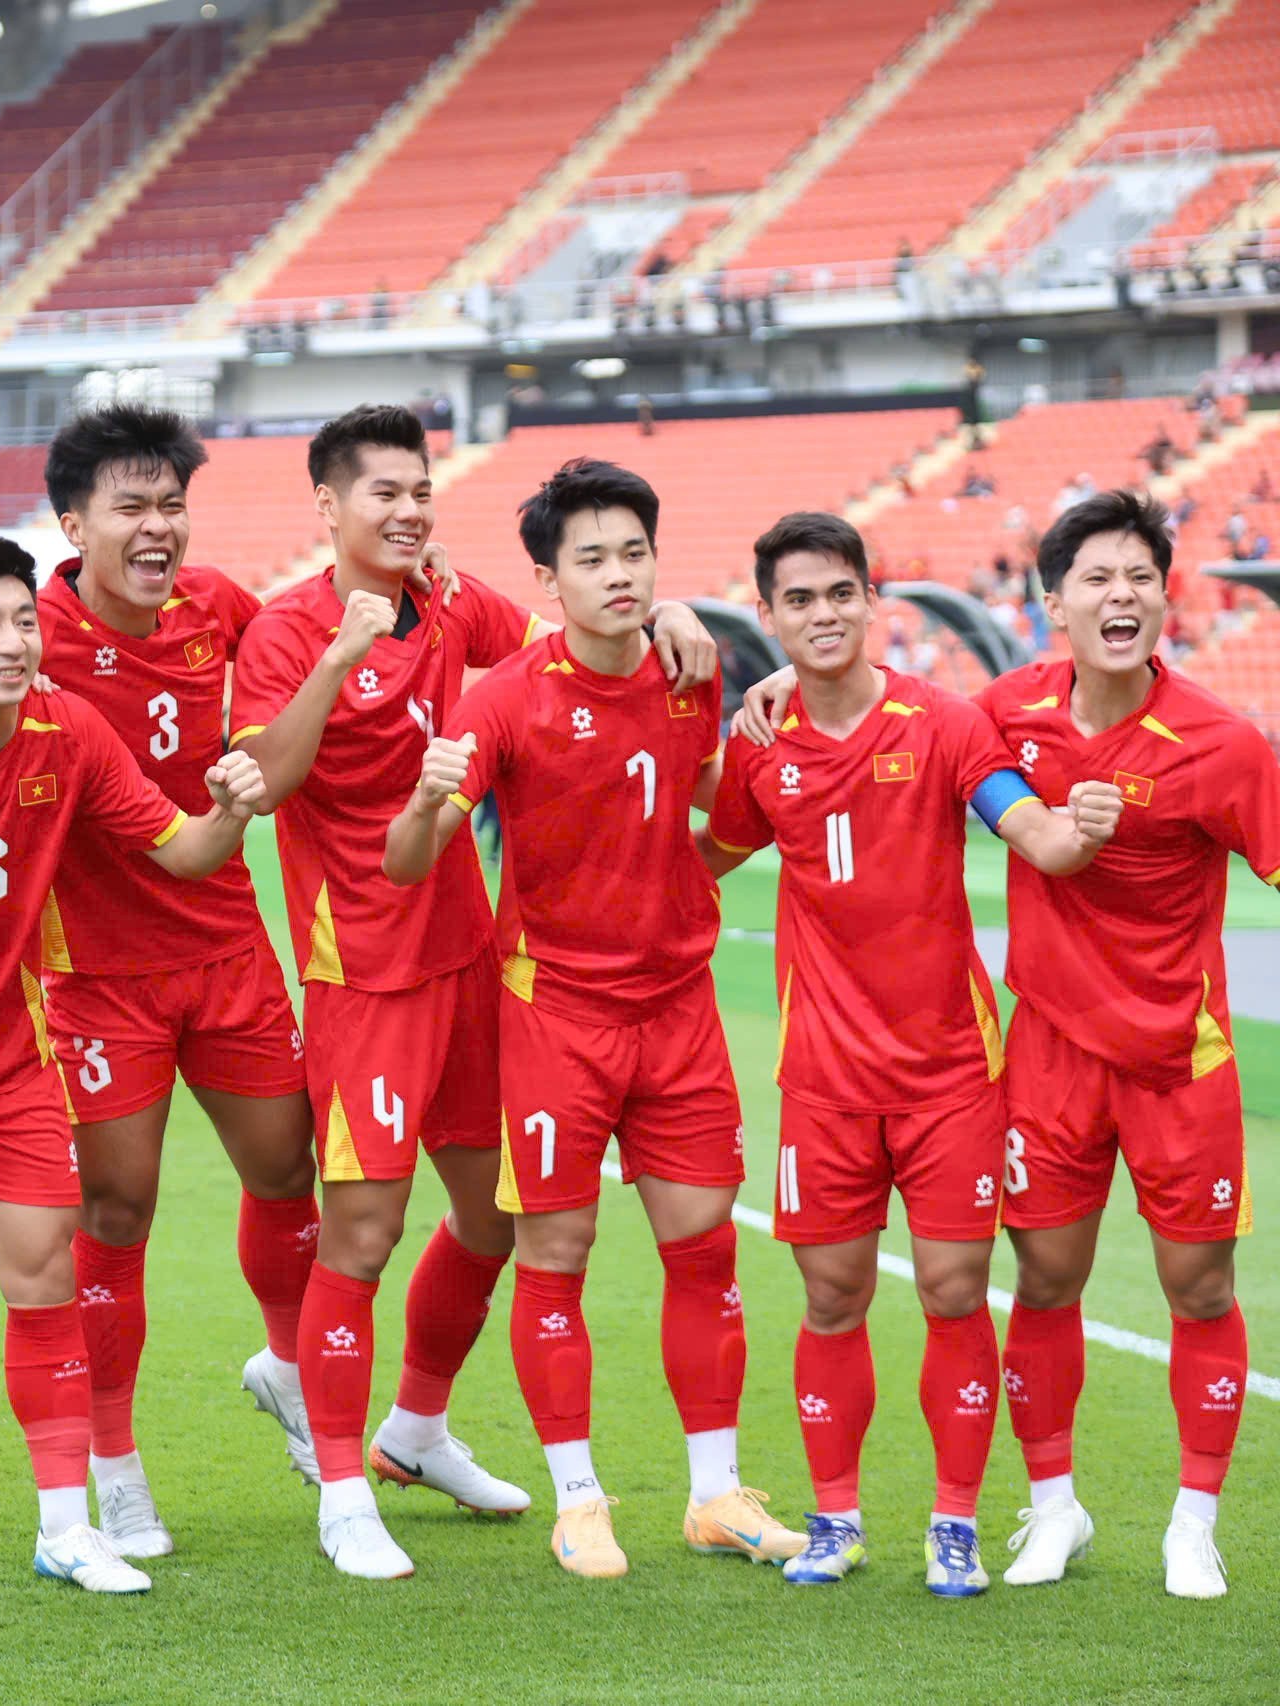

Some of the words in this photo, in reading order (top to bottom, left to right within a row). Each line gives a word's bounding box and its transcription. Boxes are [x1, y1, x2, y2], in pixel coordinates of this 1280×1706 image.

[147, 691, 180, 761] 3
[626, 749, 657, 820] 7
[826, 812, 855, 883] 11
[73, 1036, 113, 1094] 3
[371, 1075, 405, 1144] 4
[524, 1110, 557, 1180] 7
[779, 1144, 801, 1213] 11
